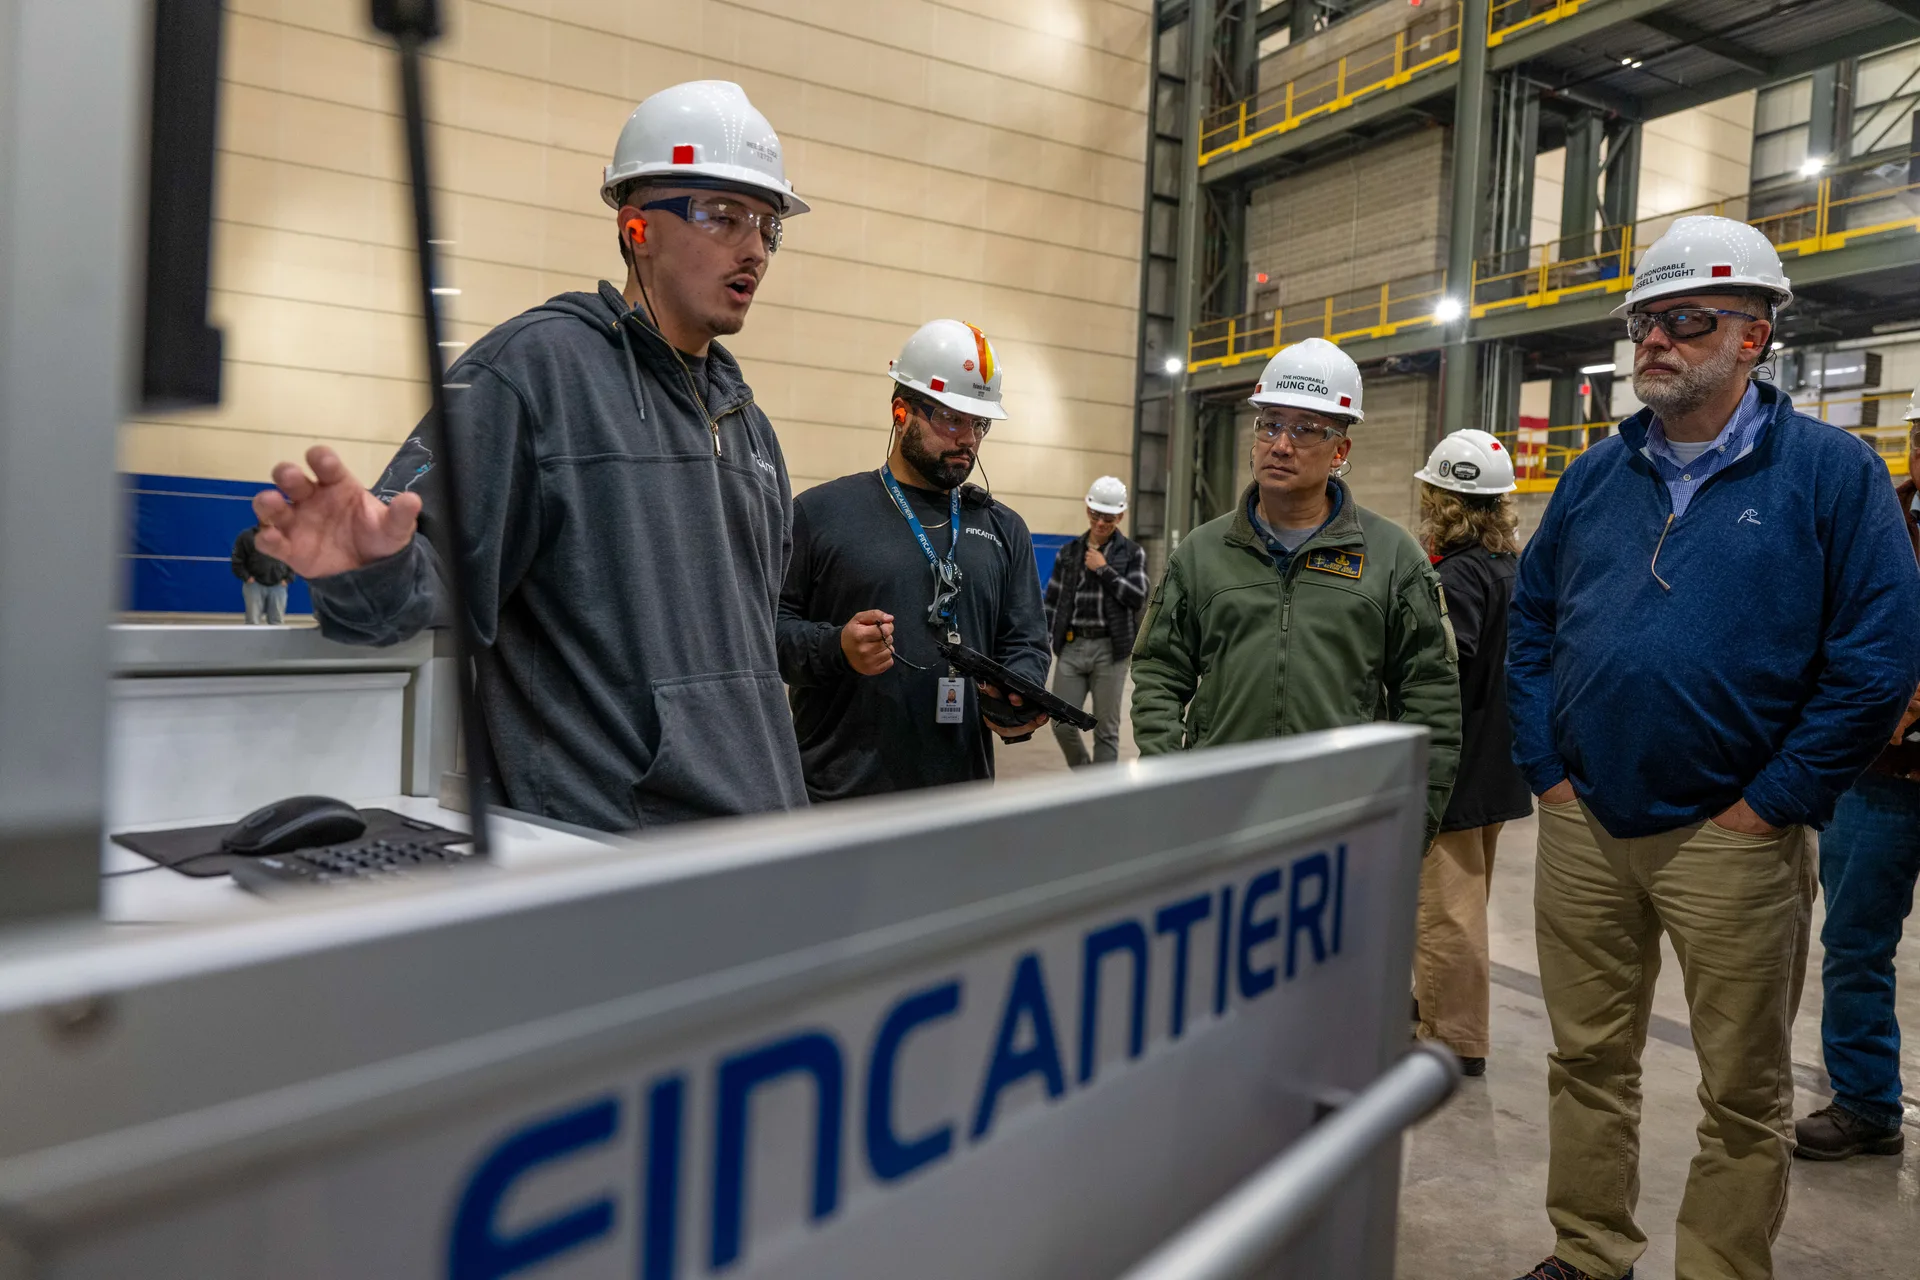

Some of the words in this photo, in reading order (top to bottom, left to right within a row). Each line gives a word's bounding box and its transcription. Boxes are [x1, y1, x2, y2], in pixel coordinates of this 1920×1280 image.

[1644, 262, 1686, 278] HONORABLE
[1655, 268, 1696, 282] VOUGHT
[1293, 375, 1325, 385] HONORABLE
[1276, 381, 1305, 390] HUNG
[1307, 383, 1329, 396] CAO
[965, 527, 1003, 548] FINCANT
[918, 533, 940, 568] FINCANTIE
[446, 845, 1347, 1280] FINCANTIERI
